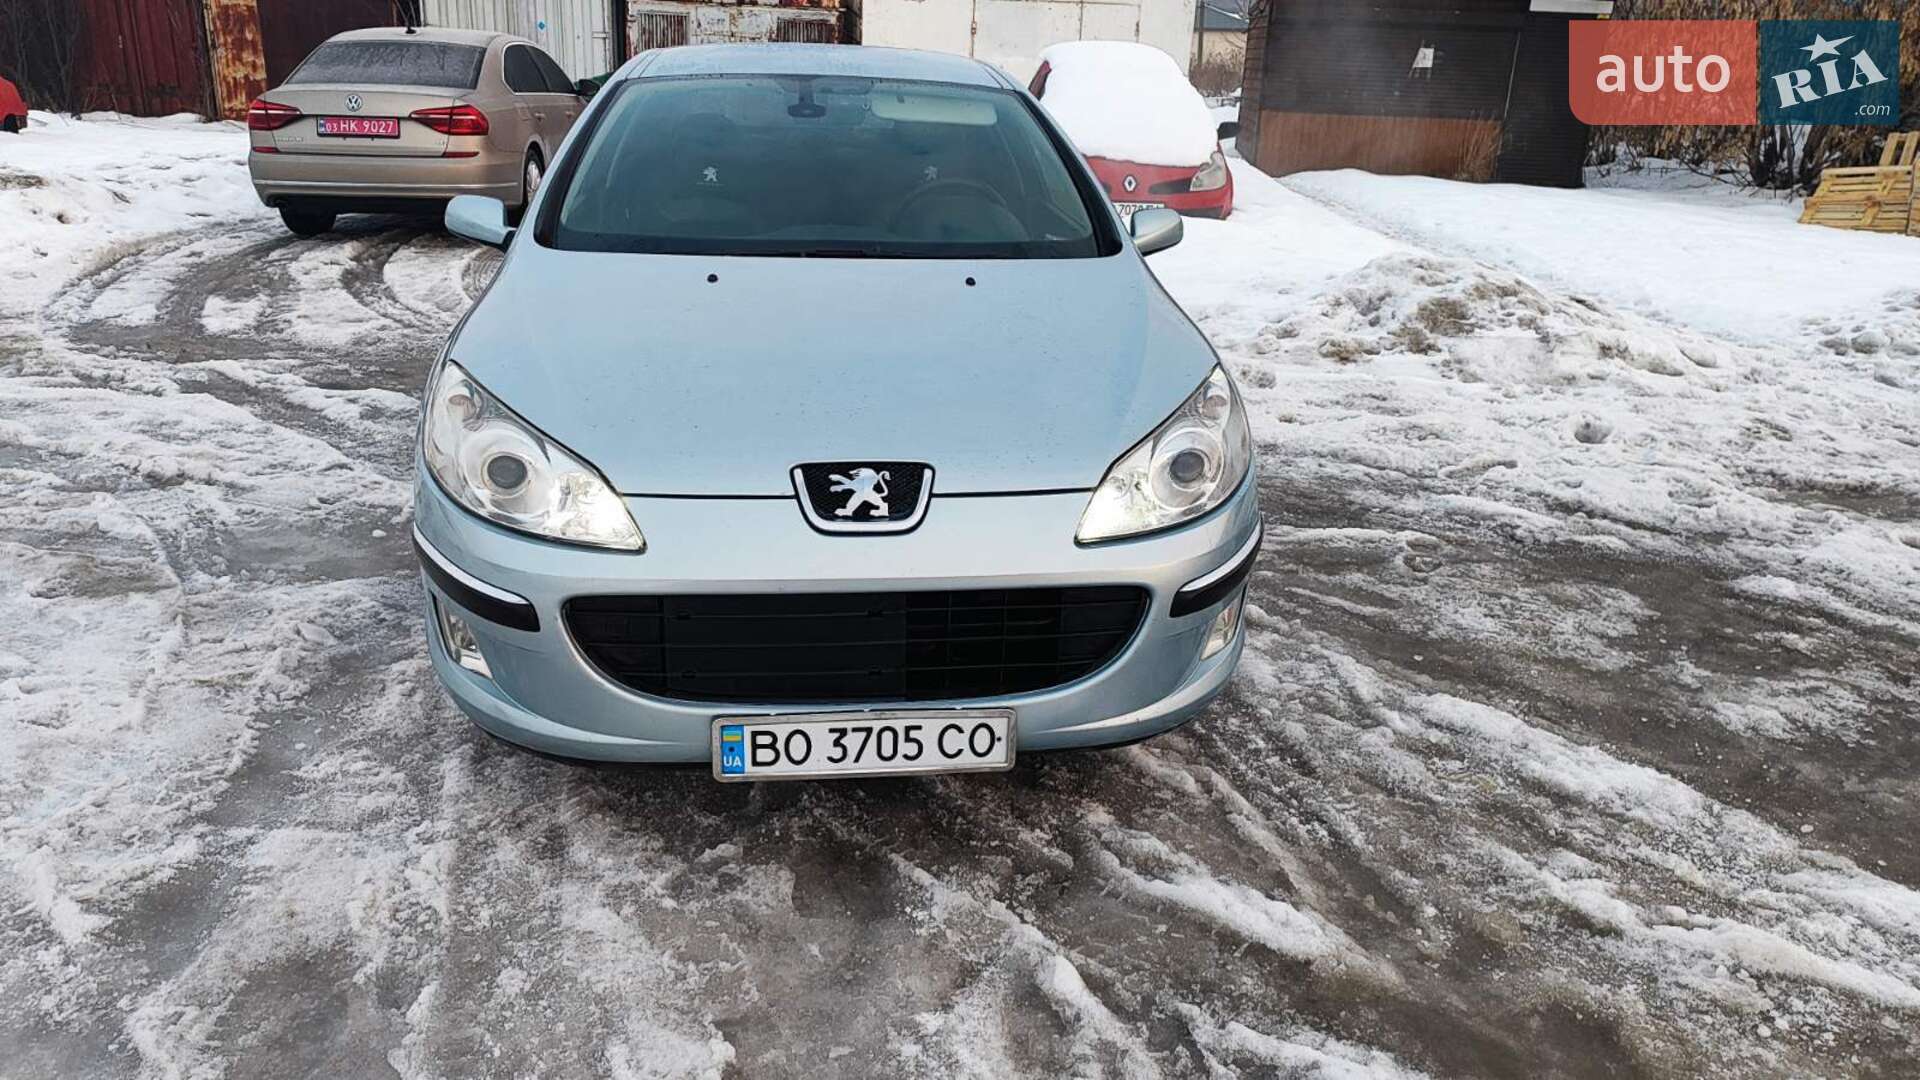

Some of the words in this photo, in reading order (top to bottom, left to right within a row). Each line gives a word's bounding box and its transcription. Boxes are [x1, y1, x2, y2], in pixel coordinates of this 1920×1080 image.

[326, 122, 338, 132] 03
[340, 120, 358, 132] HK
[363, 121, 393, 133] 9027
[750, 728, 812, 768] BO
[827, 724, 924, 764] 3705
[937, 722, 996, 759] CO
[723, 755, 742, 769] UA
